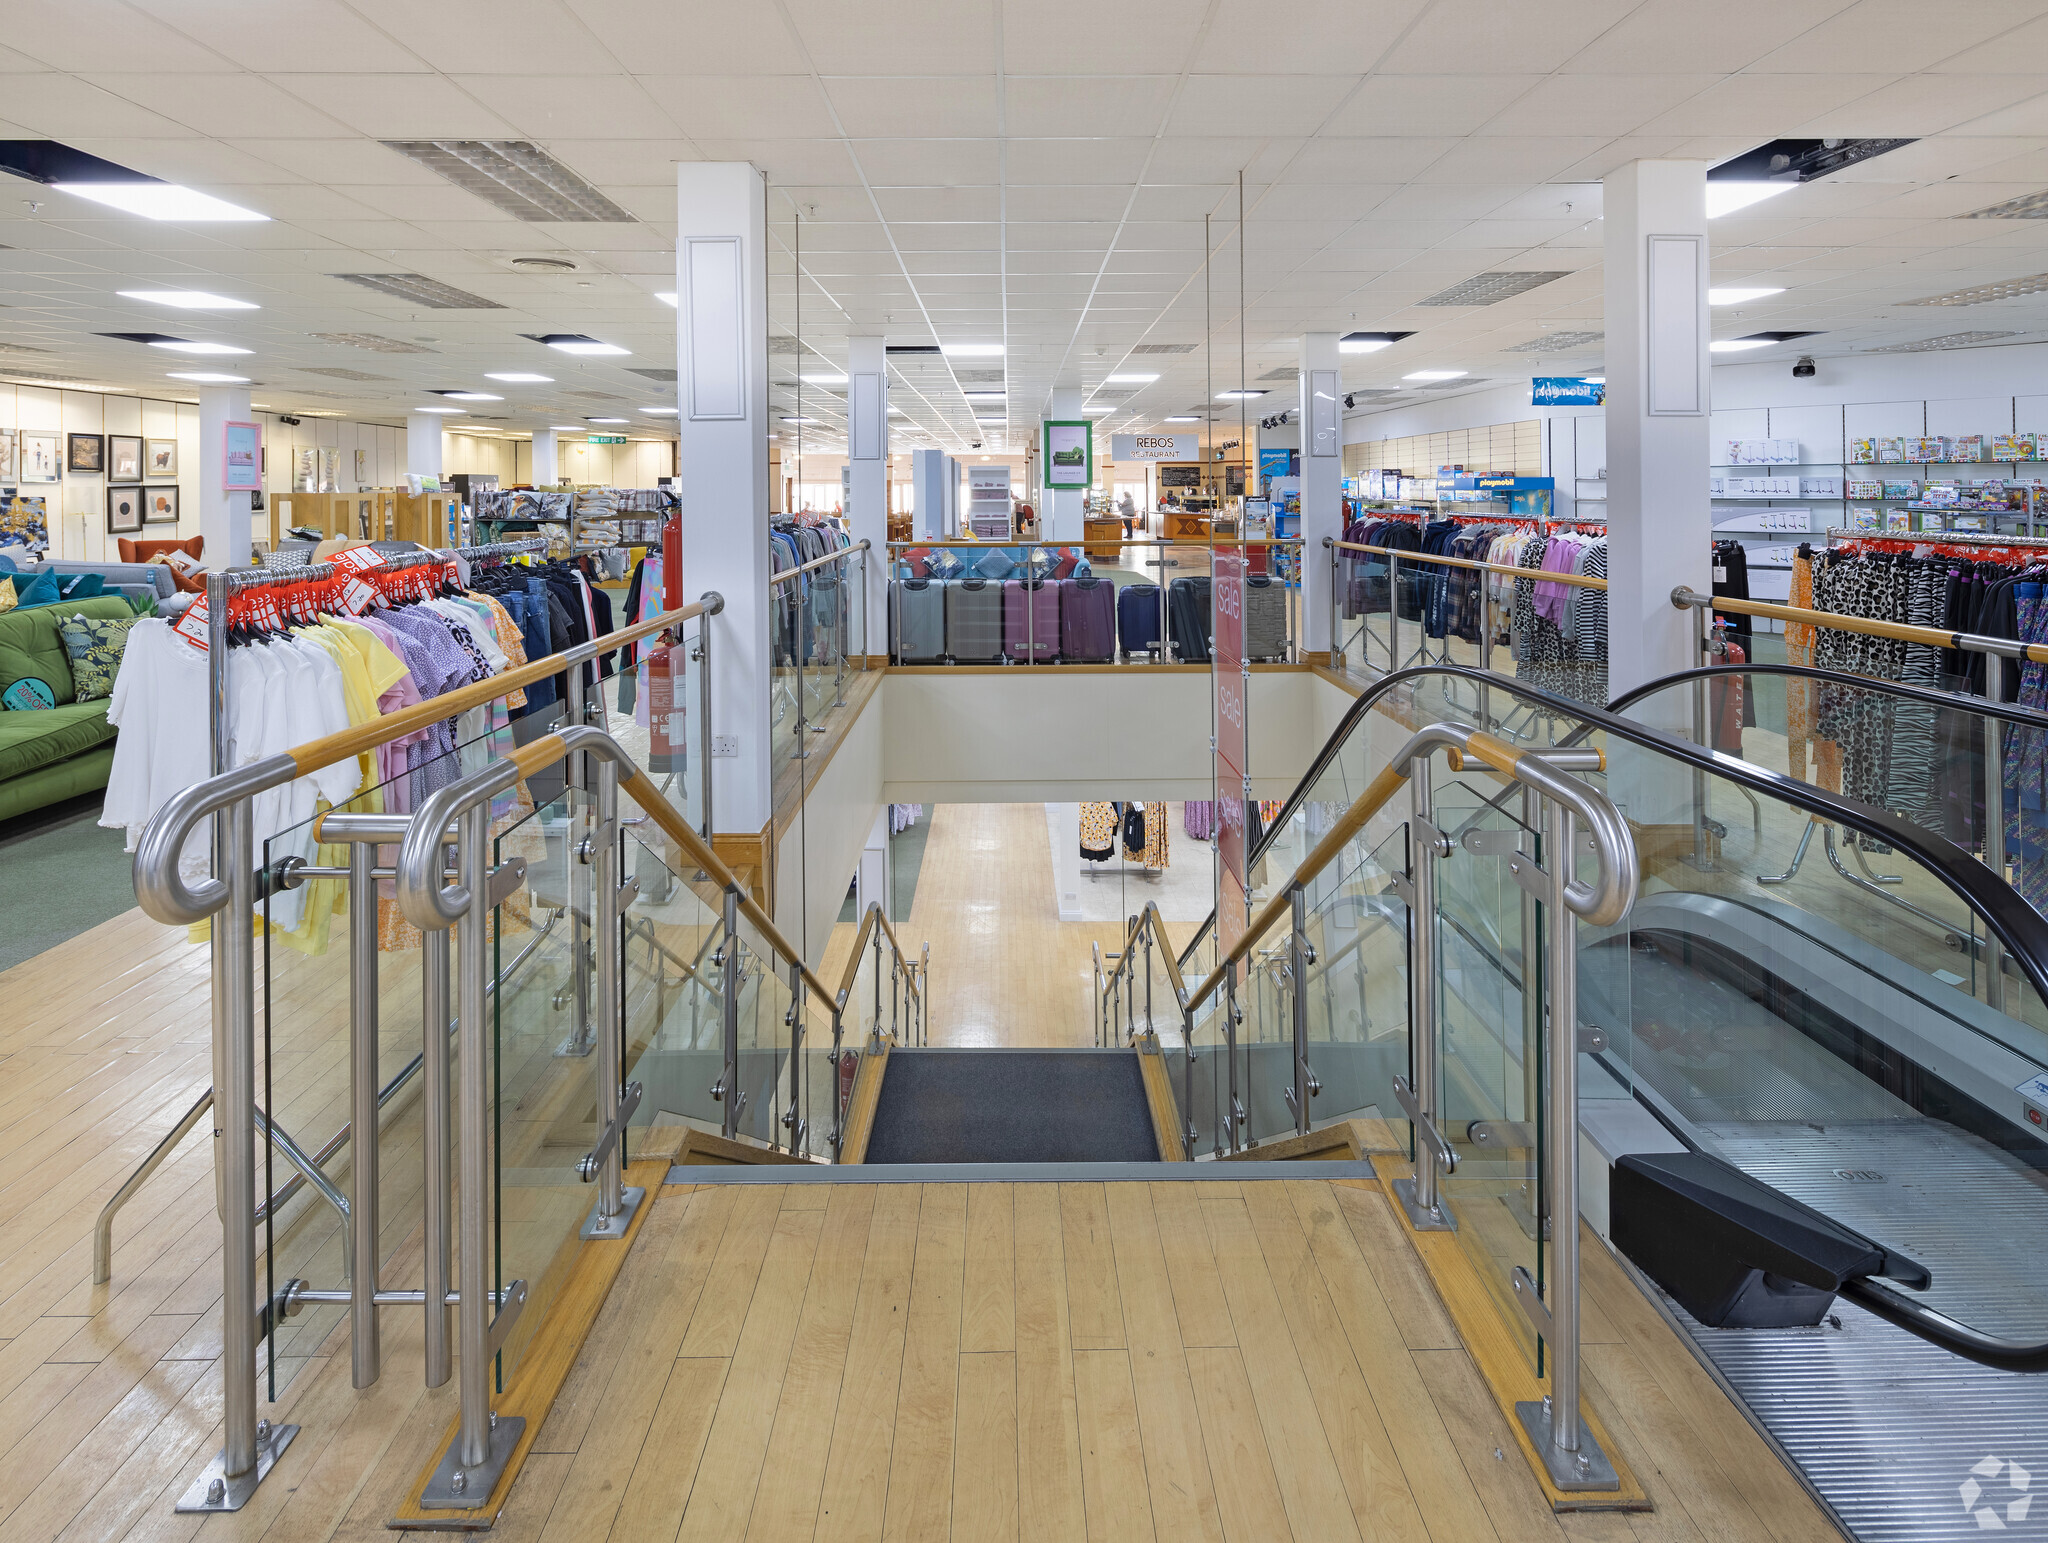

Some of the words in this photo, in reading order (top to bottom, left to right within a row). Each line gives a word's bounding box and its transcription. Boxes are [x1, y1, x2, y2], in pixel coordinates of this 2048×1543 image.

[1535, 384, 1591, 399] playmobil
[1136, 437, 1174, 448] REBOS
[1480, 478, 1514, 488] playmobil
[335, 553, 360, 574] sale
[1218, 577, 1240, 620] sale
[17, 684, 35, 703] 20%
[1220, 684, 1241, 728] sale
[1220, 787, 1242, 838] sale
[1840, 1170, 1884, 1181] OTIS
